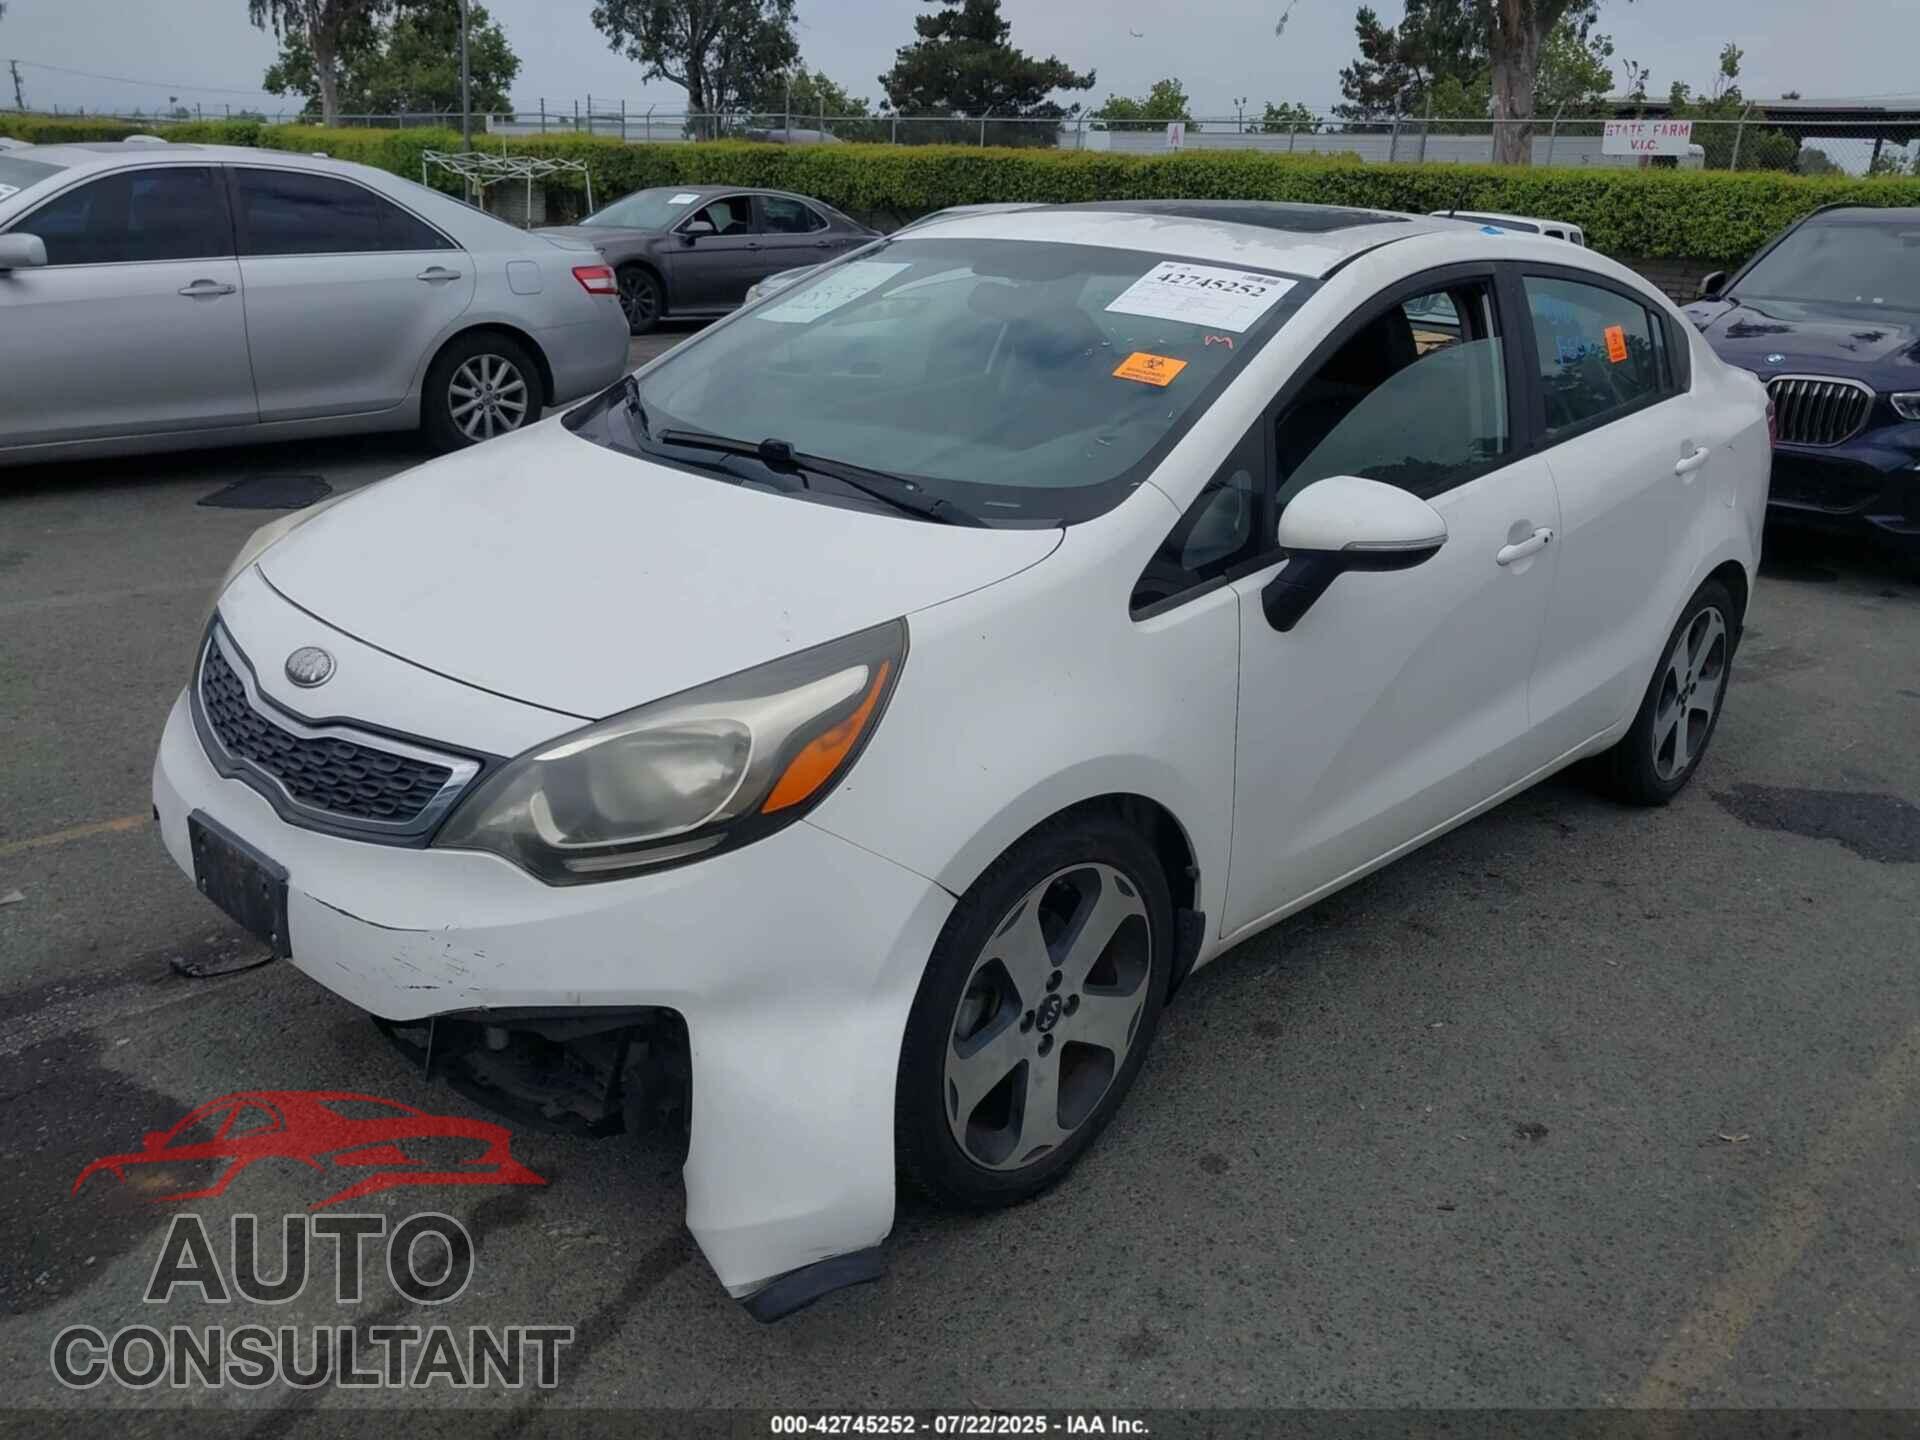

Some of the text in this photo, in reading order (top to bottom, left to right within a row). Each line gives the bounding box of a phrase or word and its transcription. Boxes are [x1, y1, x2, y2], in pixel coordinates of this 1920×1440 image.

[1170, 126, 1180, 145] A
[1605, 123, 1689, 136] STATE FARM
[1157, 273, 1267, 297] 42745252
